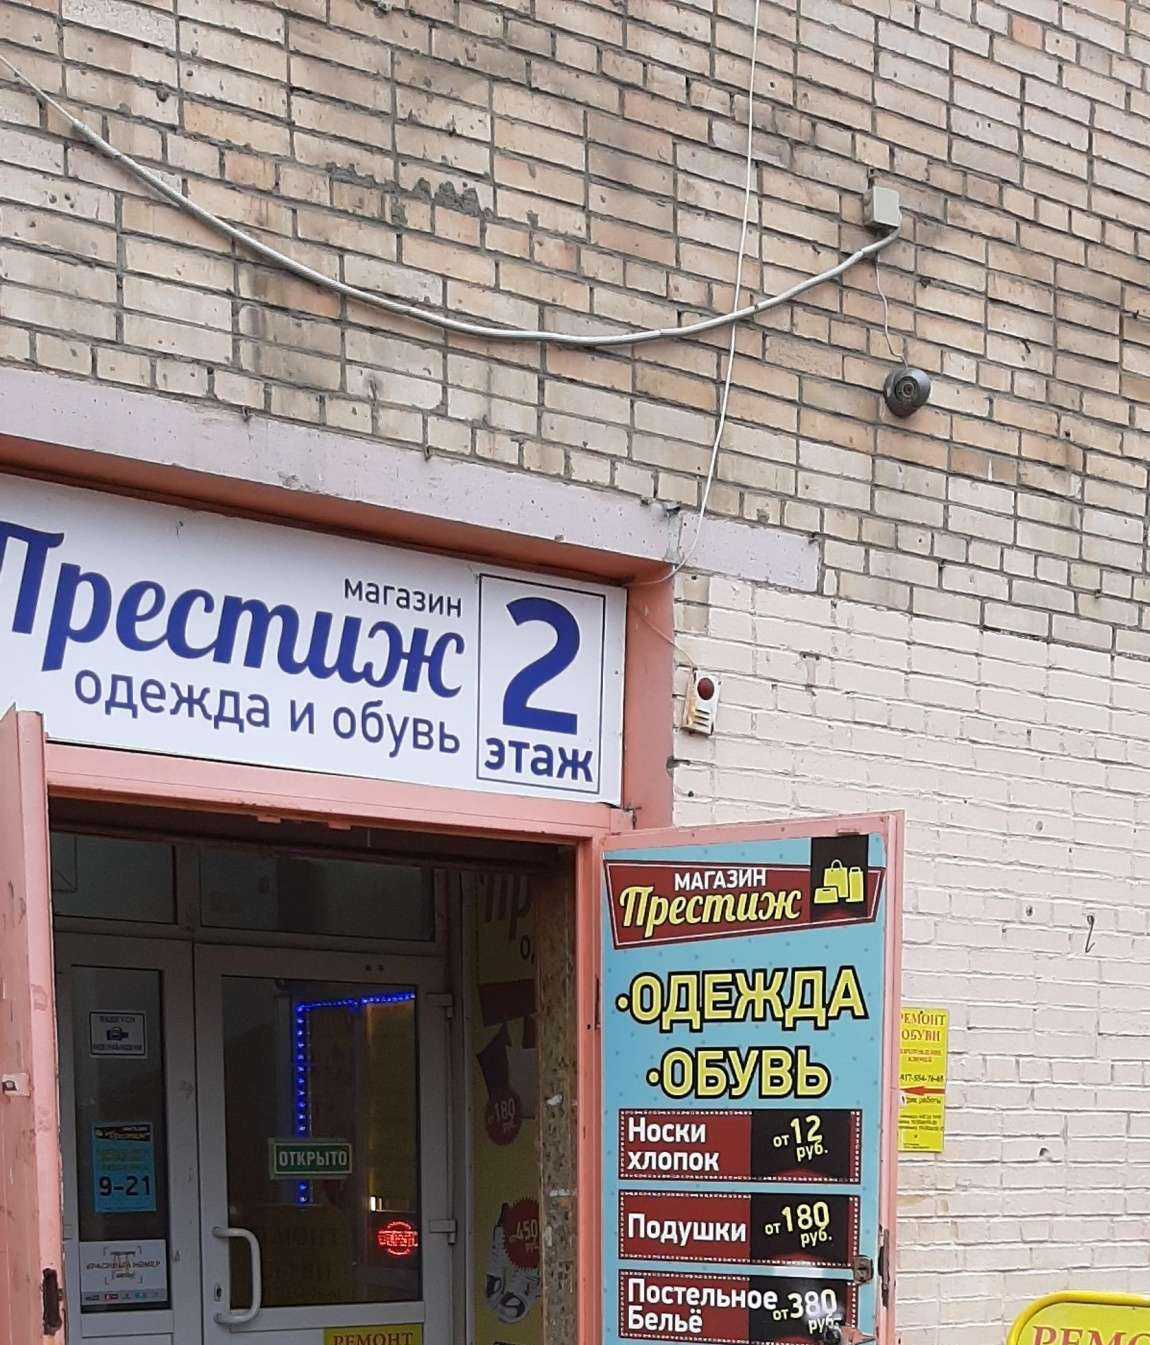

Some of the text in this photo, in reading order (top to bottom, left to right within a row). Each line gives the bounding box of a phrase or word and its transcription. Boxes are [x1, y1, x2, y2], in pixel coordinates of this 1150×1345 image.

[0, 520, 465, 699] Престиж
[344, 578, 463, 618] магазин
[503, 597, 581, 735] 2
[75, 669, 461, 760] одежда и обувь
[485, 737, 593, 783] этаж
[674, 868, 767, 891] МАГАЗИН
[619, 886, 801, 938] Престиж
[900, 1013, 946, 1025] ЕМОНТ
[628, 1117, 706, 1143] Носки
[773, 1115, 822, 1148] от 12
[279, 1150, 347, 1167] ОТКРЫТО
[627, 1150, 719, 1172] хлопок
[796, 1140, 828, 1162] руб.
[99, 1175, 150, 1197] 9-21
[515, 1219, 538, 1241] 450
[628, 1213, 746, 1246] Подушки
[765, 1201, 830, 1236] от 180
[800, 1228, 832, 1248] руб.
[628, 1278, 778, 1310] Постельное
[772, 1288, 837, 1321] от 380
[628, 1305, 702, 1333] Бельё
